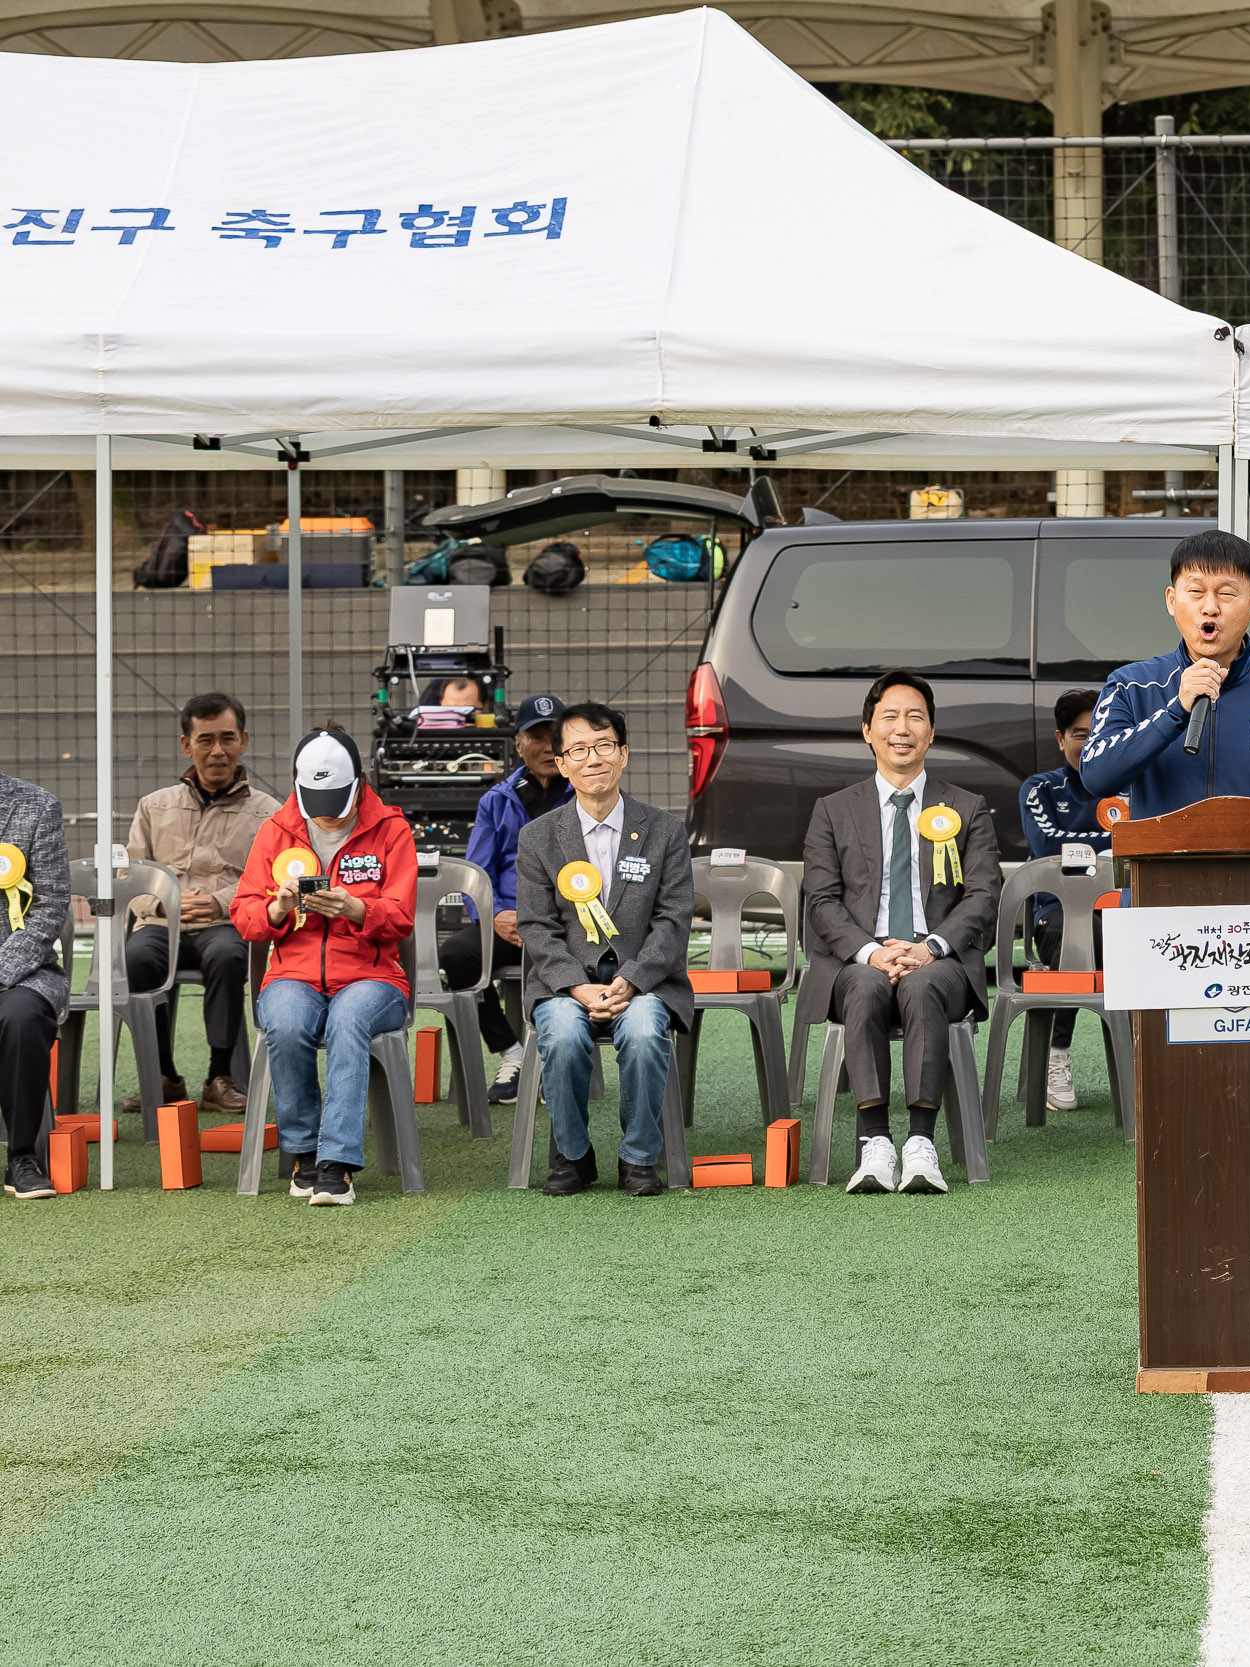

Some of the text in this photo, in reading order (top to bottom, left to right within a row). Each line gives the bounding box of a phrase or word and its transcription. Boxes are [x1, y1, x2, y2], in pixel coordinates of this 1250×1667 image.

[211, 197, 568, 249] 축구협회
[1067, 850, 1092, 859] 구의원
[1197, 925, 1223, 940] 개청
